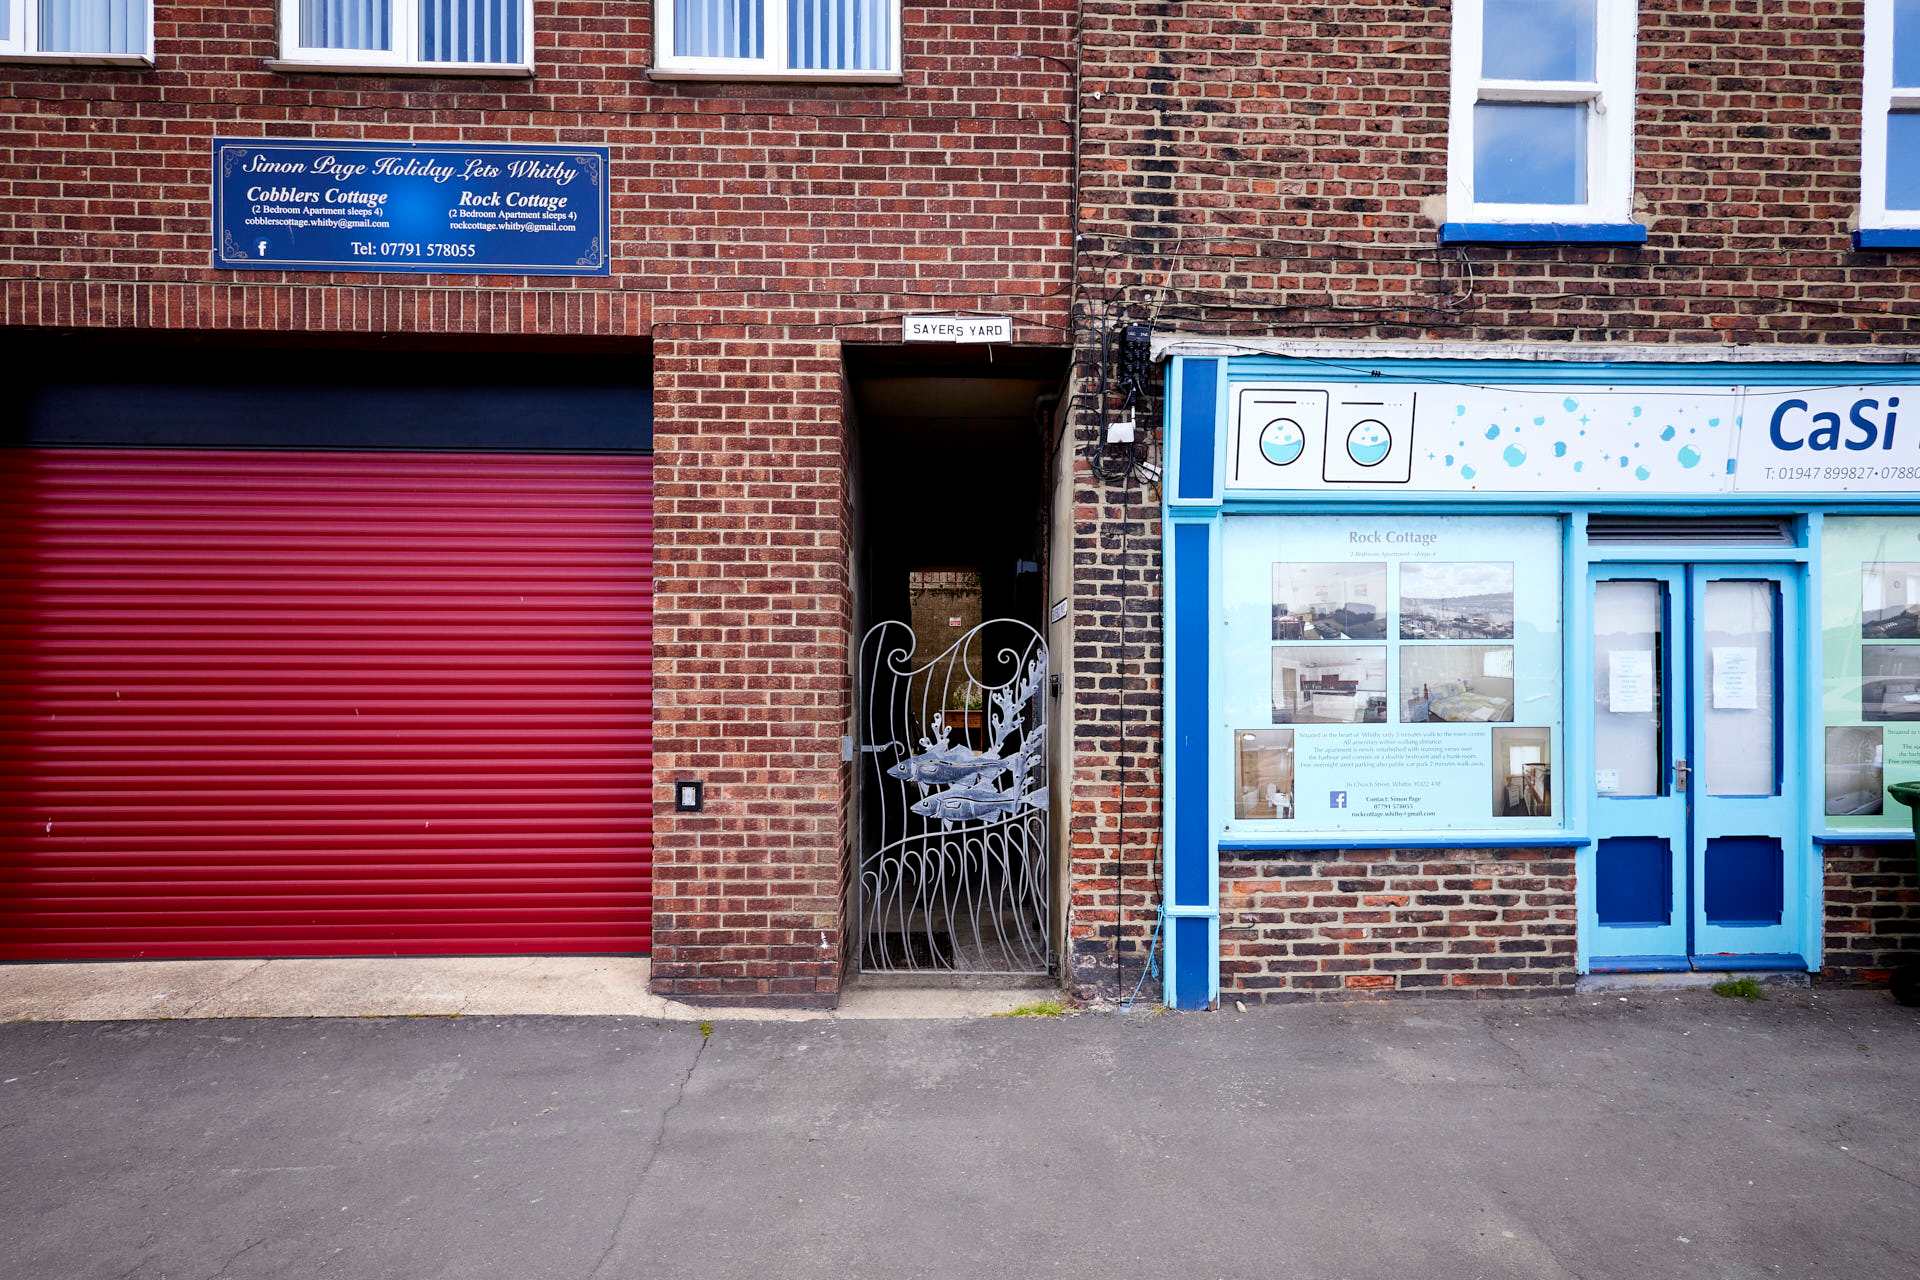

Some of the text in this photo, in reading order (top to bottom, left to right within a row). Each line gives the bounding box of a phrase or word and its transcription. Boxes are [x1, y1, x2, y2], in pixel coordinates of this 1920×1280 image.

[242, 154, 579, 186] Simon Page Holiday Lets Whitby
[247, 186, 388, 208] Cobblers Cottage
[459, 191, 568, 211] Rock Cottage
[252, 205, 384, 217] (2 Bedroom Apartment sleeps 4)
[448, 209, 577, 221] (2 Bedroom Apartment sleeps 4)
[245, 217, 390, 229] cobblerscottage.whitby@gmail.com
[450, 221, 576, 232] rockcottage.whitby@gmail.com
[351, 242, 476, 257] Tel: 07791 578055
[913, 324, 1003, 336] SAYERS YARD
[1769, 397, 1900, 451] CaSi
[1764, 467, 1774, 480] T:
[1779, 467, 1821, 480] 01947
[1349, 530, 1437, 547] Rock Cottage
